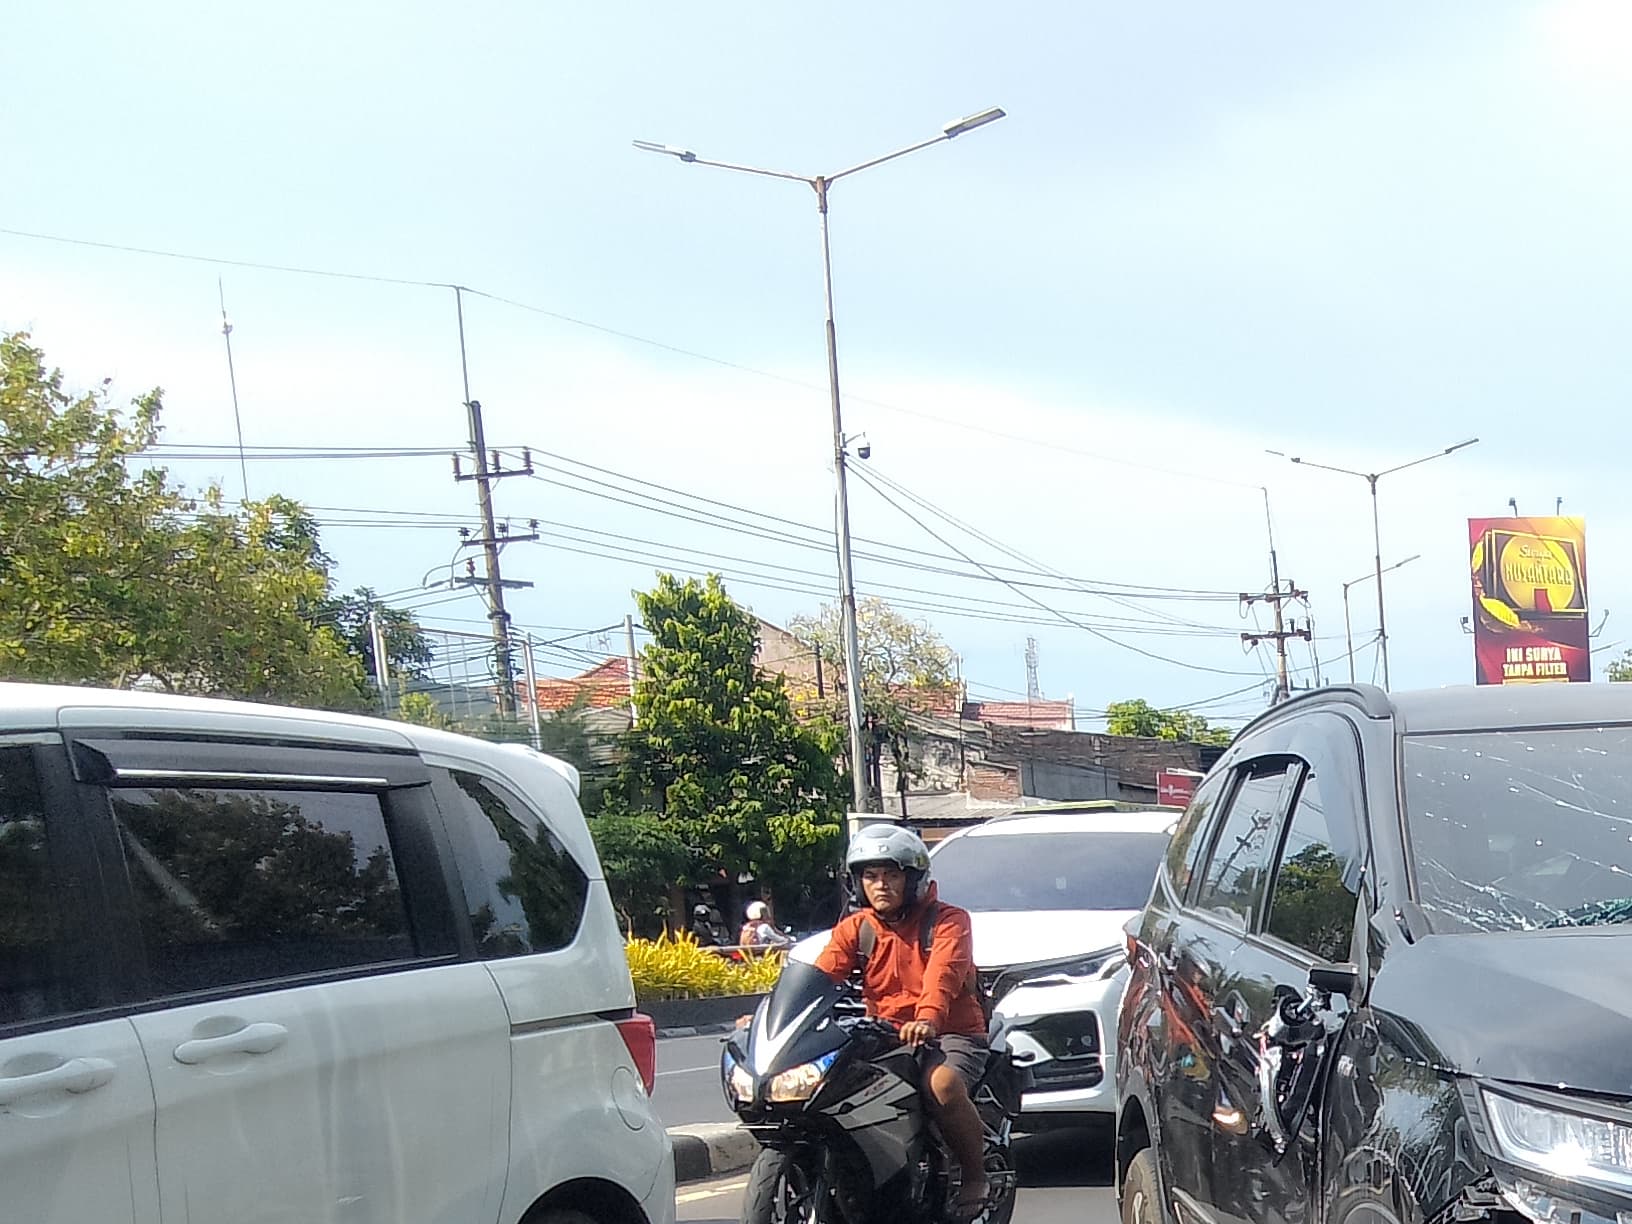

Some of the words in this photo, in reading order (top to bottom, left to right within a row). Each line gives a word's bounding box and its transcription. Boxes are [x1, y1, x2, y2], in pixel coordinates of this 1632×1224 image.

[1506, 647, 1523, 662] INI
[1525, 646, 1562, 661] SURYA
[1502, 663, 1534, 676] TANPA
[1535, 662, 1567, 675] FILTER
